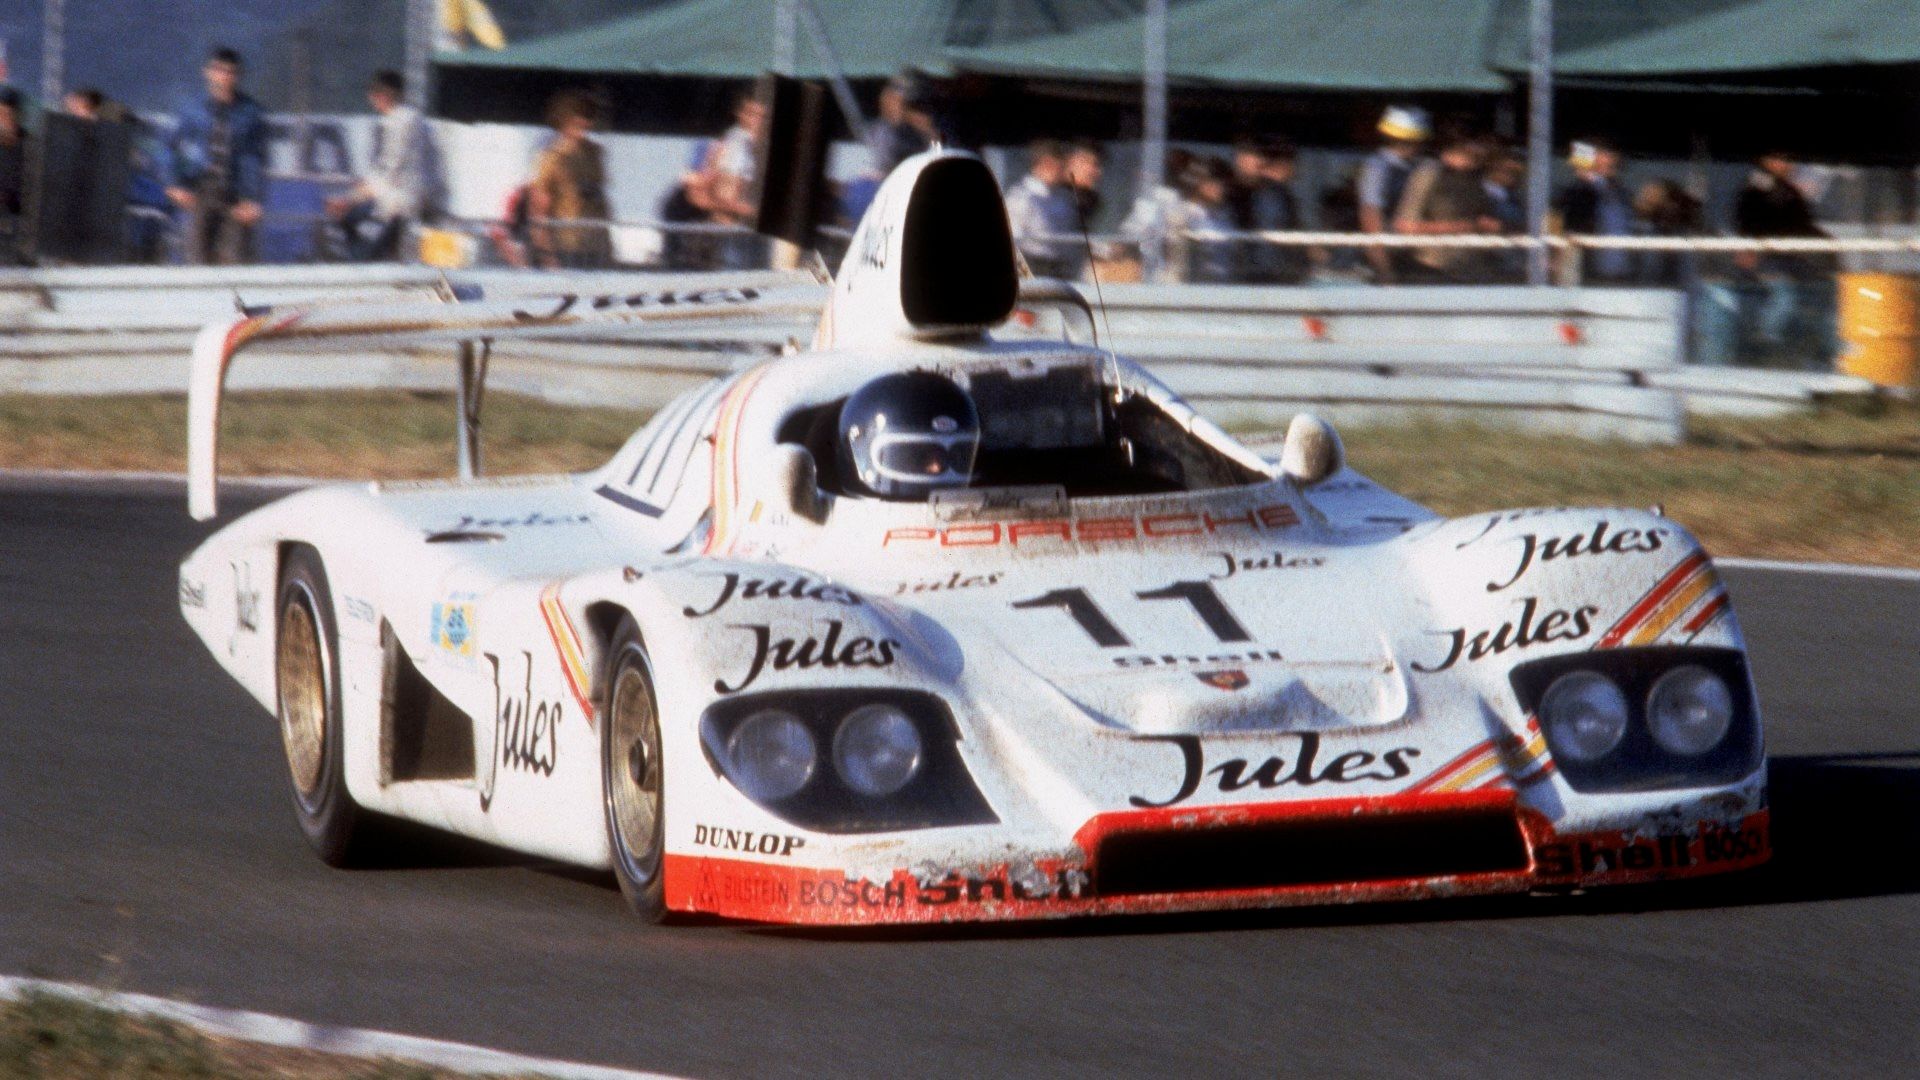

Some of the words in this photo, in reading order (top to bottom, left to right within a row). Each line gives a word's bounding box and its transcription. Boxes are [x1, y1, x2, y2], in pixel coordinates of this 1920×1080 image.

[883, 505, 1300, 547] PORSCHE
[1206, 551, 1325, 579] Jules
[1486, 521, 1669, 592] Jules
[683, 572, 862, 617] Jules
[1012, 579, 1257, 648] 11
[714, 619, 900, 694] Jules
[1411, 597, 1598, 673] Jules
[480, 651, 562, 813] Jules
[1129, 731, 1421, 808] Jules
[692, 824, 806, 856] DUNLOP
[1533, 835, 1692, 877] Shell
[799, 879, 905, 907] BOSCH
